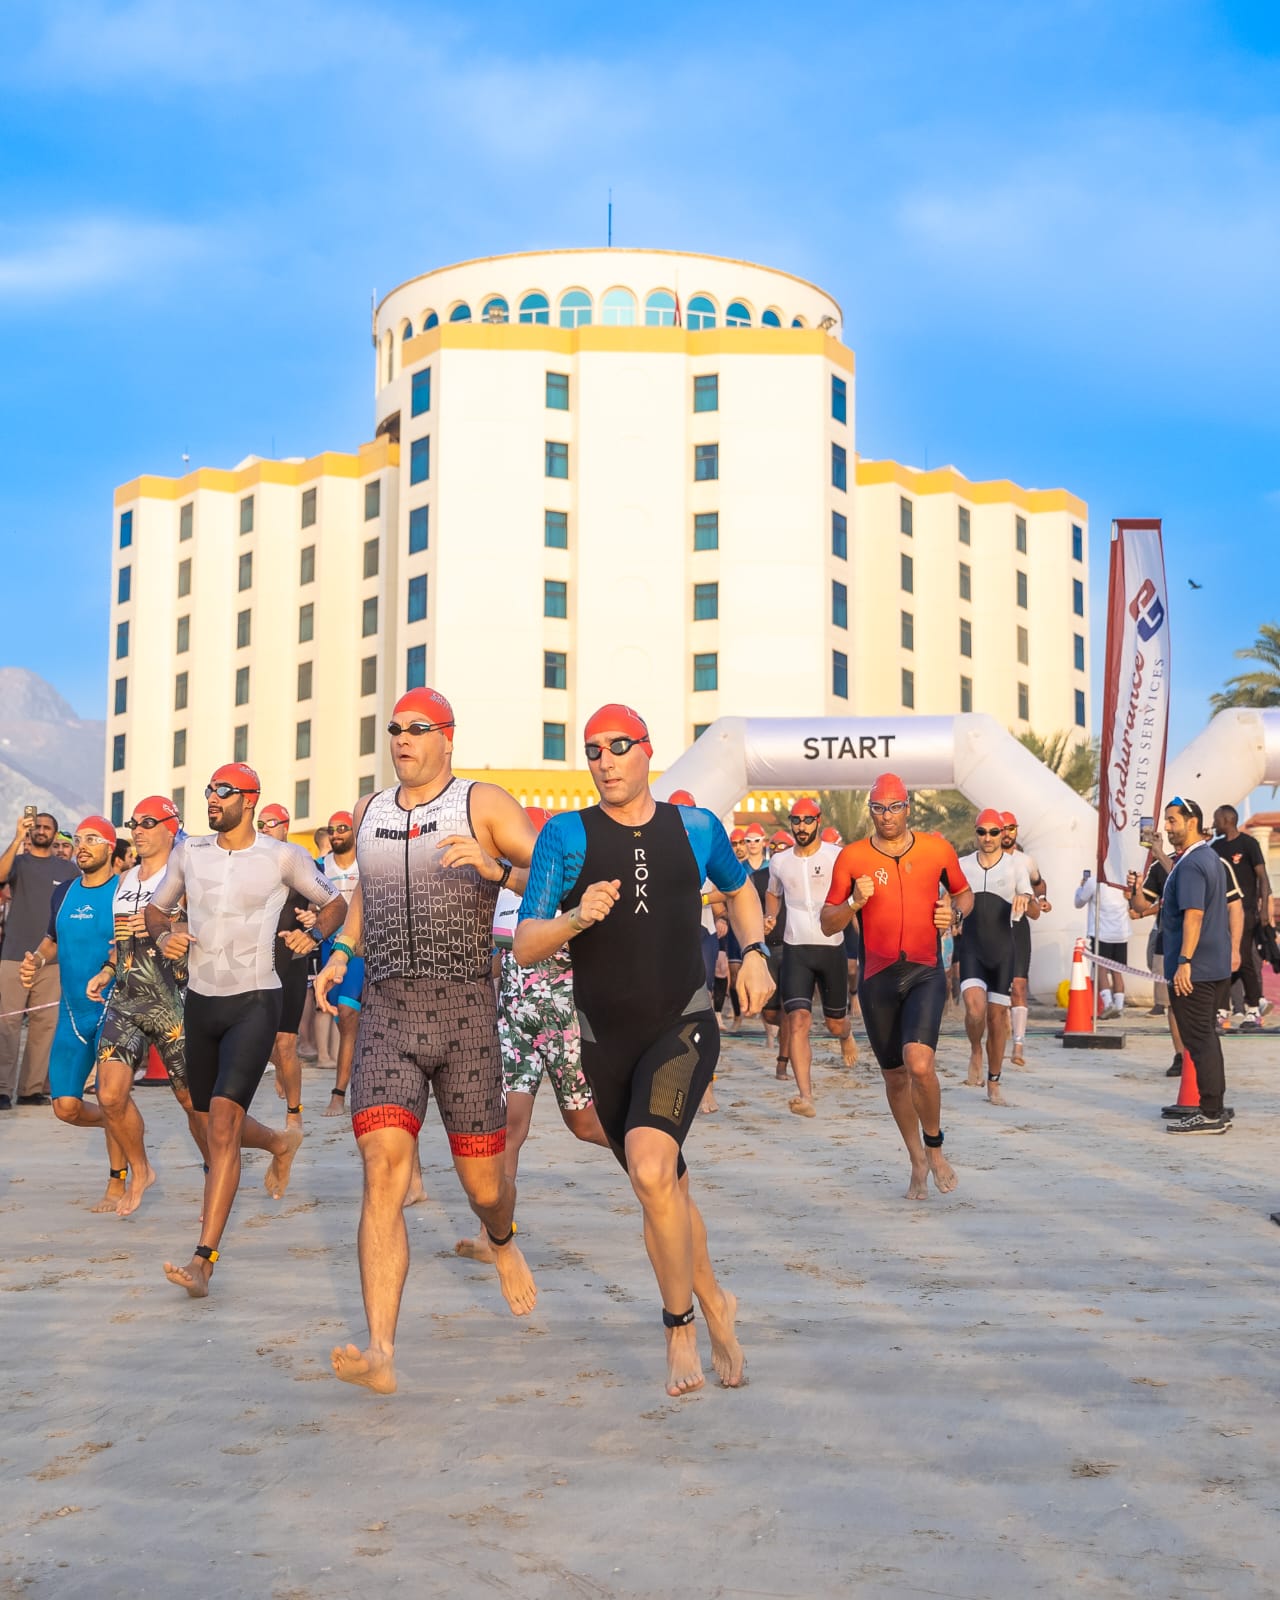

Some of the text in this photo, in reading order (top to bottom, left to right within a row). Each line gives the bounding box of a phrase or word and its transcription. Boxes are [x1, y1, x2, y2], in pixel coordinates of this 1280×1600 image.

[803, 735, 896, 760] START
[1110, 650, 1145, 831] Endurance
[1132, 658, 1164, 828] SPORTS SERVICES
[375, 820, 438, 841] IRONMAN
